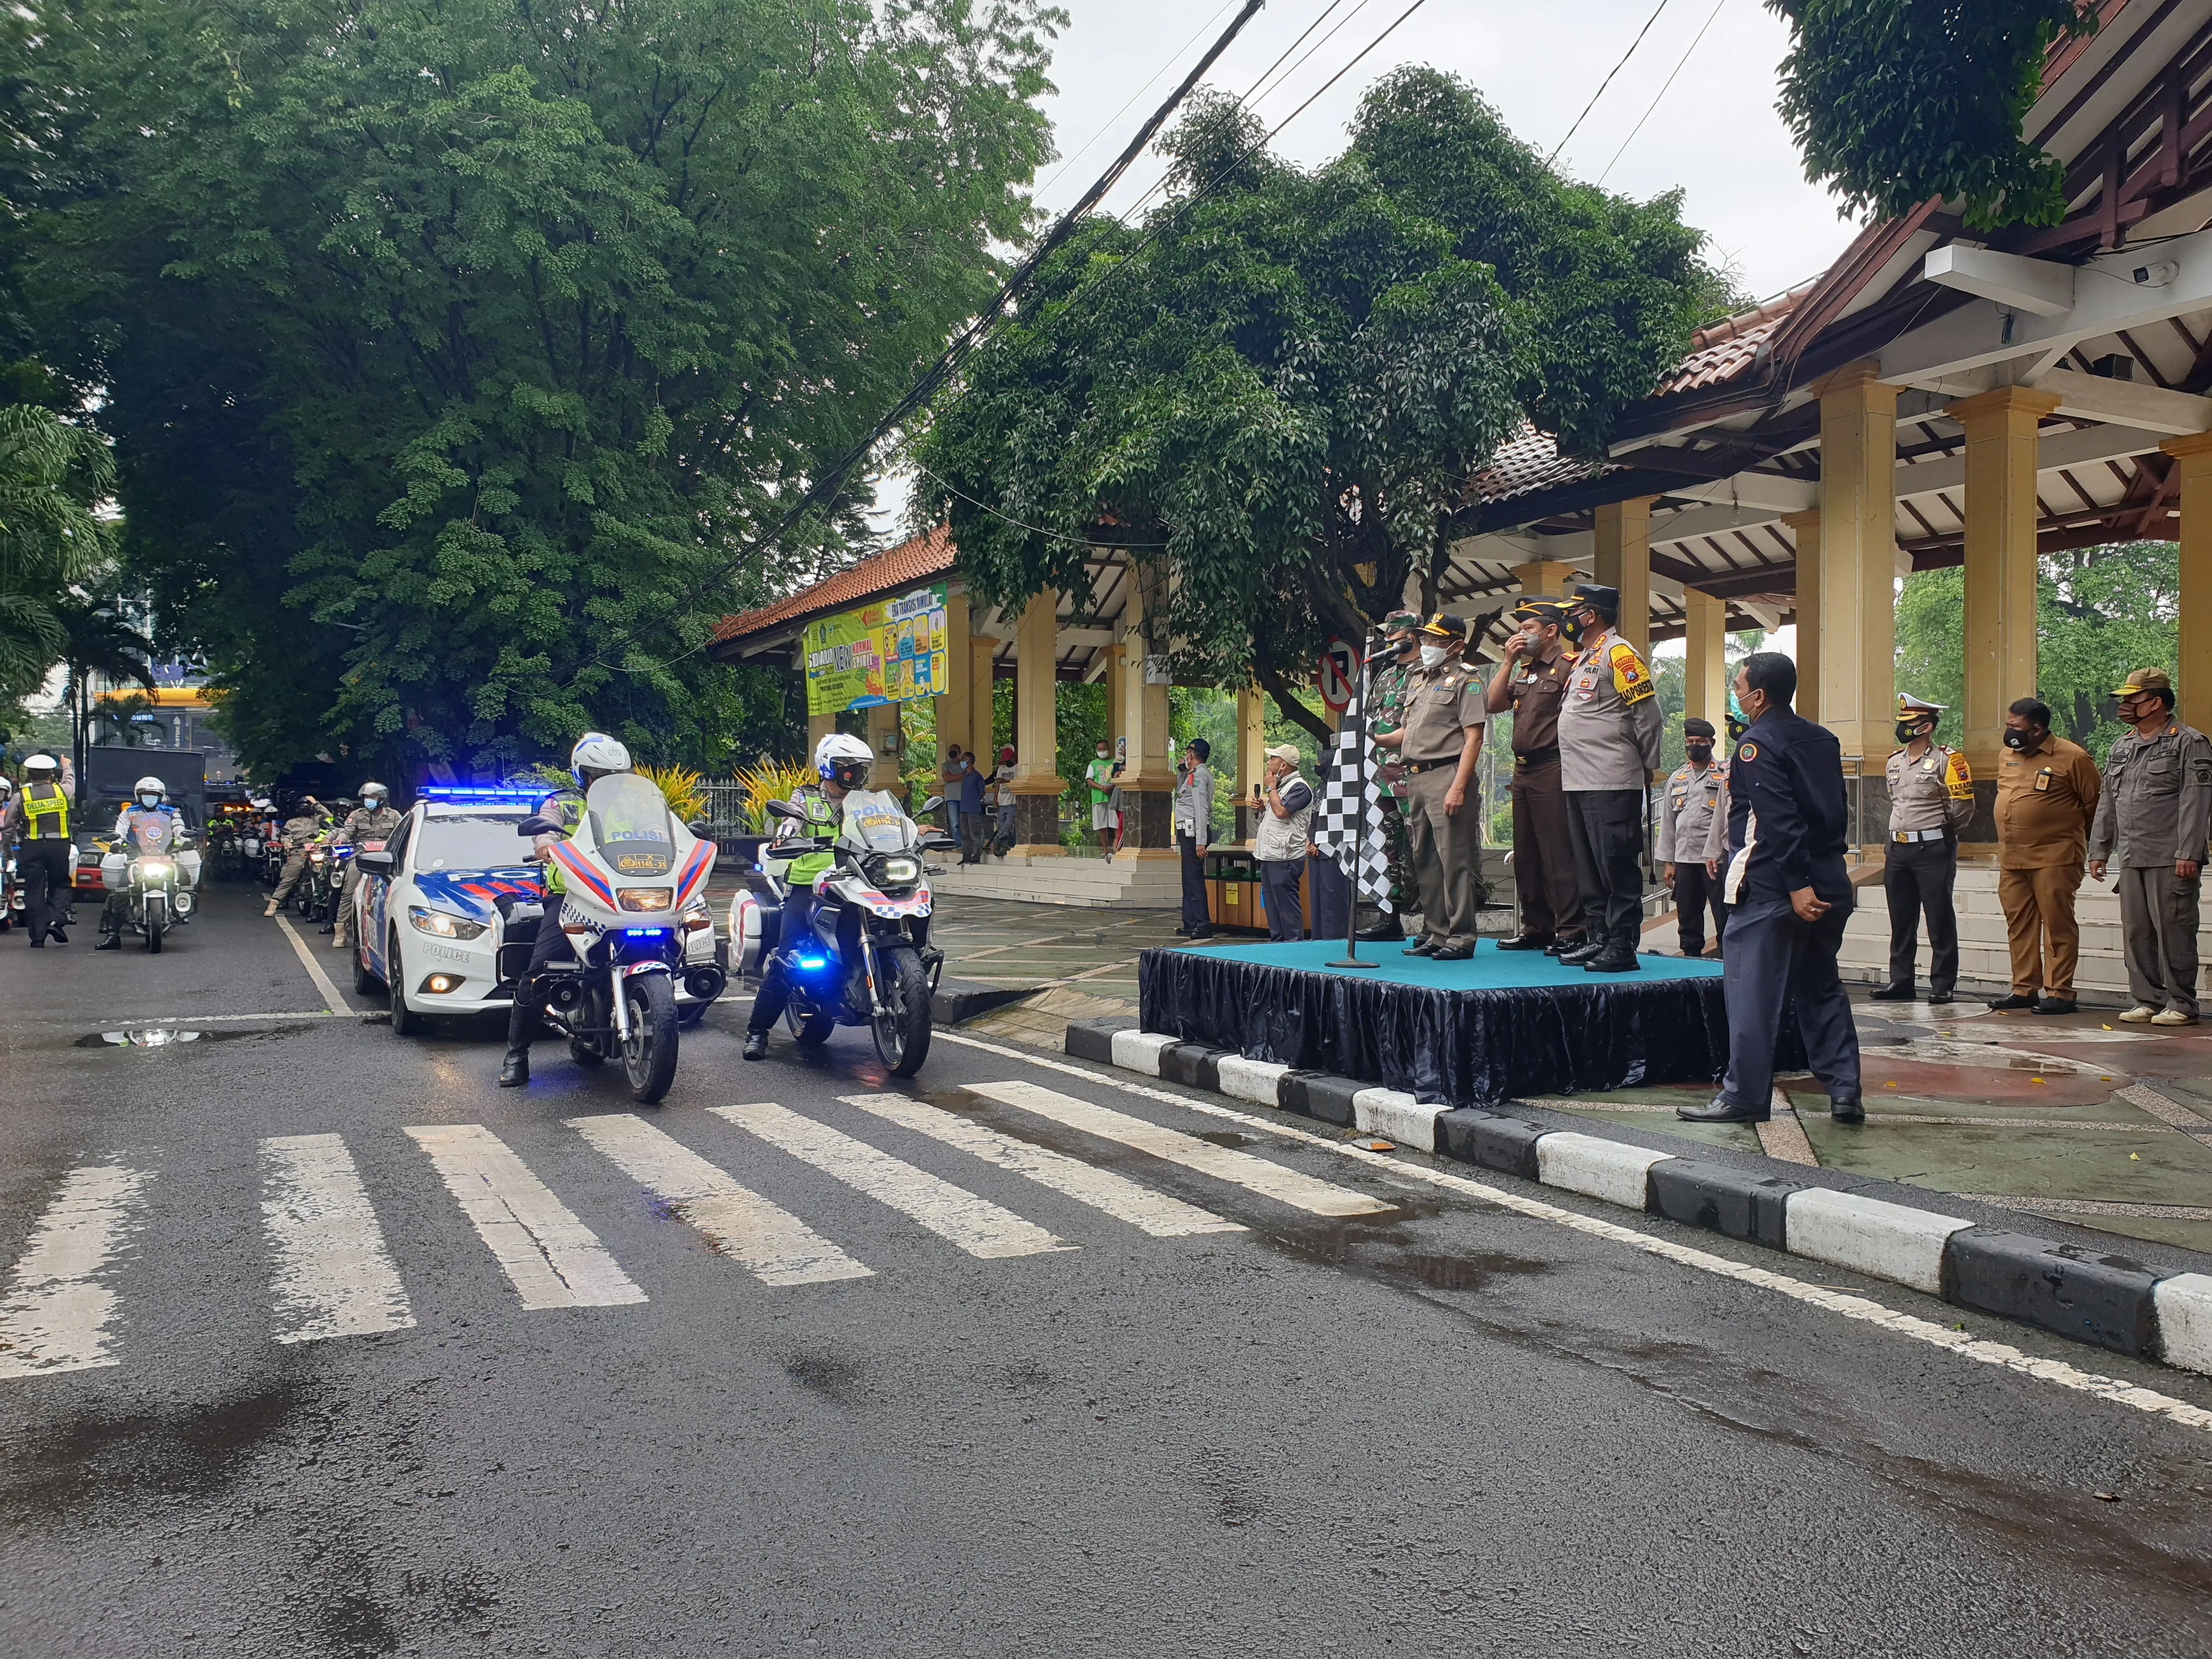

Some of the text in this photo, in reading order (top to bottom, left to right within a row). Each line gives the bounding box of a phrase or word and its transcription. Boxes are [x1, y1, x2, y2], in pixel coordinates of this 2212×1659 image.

[852, 638, 872, 655] NORMAL
[834, 644, 851, 672] NEW
[853, 653, 873, 669] SPIRIT
[27, 799, 64, 810] DELTA SPEED
[852, 805, 902, 820] POLISI
[611, 831, 663, 841] POLISI
[423, 942, 470, 963] POLICE
[686, 935, 711, 954] OLICE
